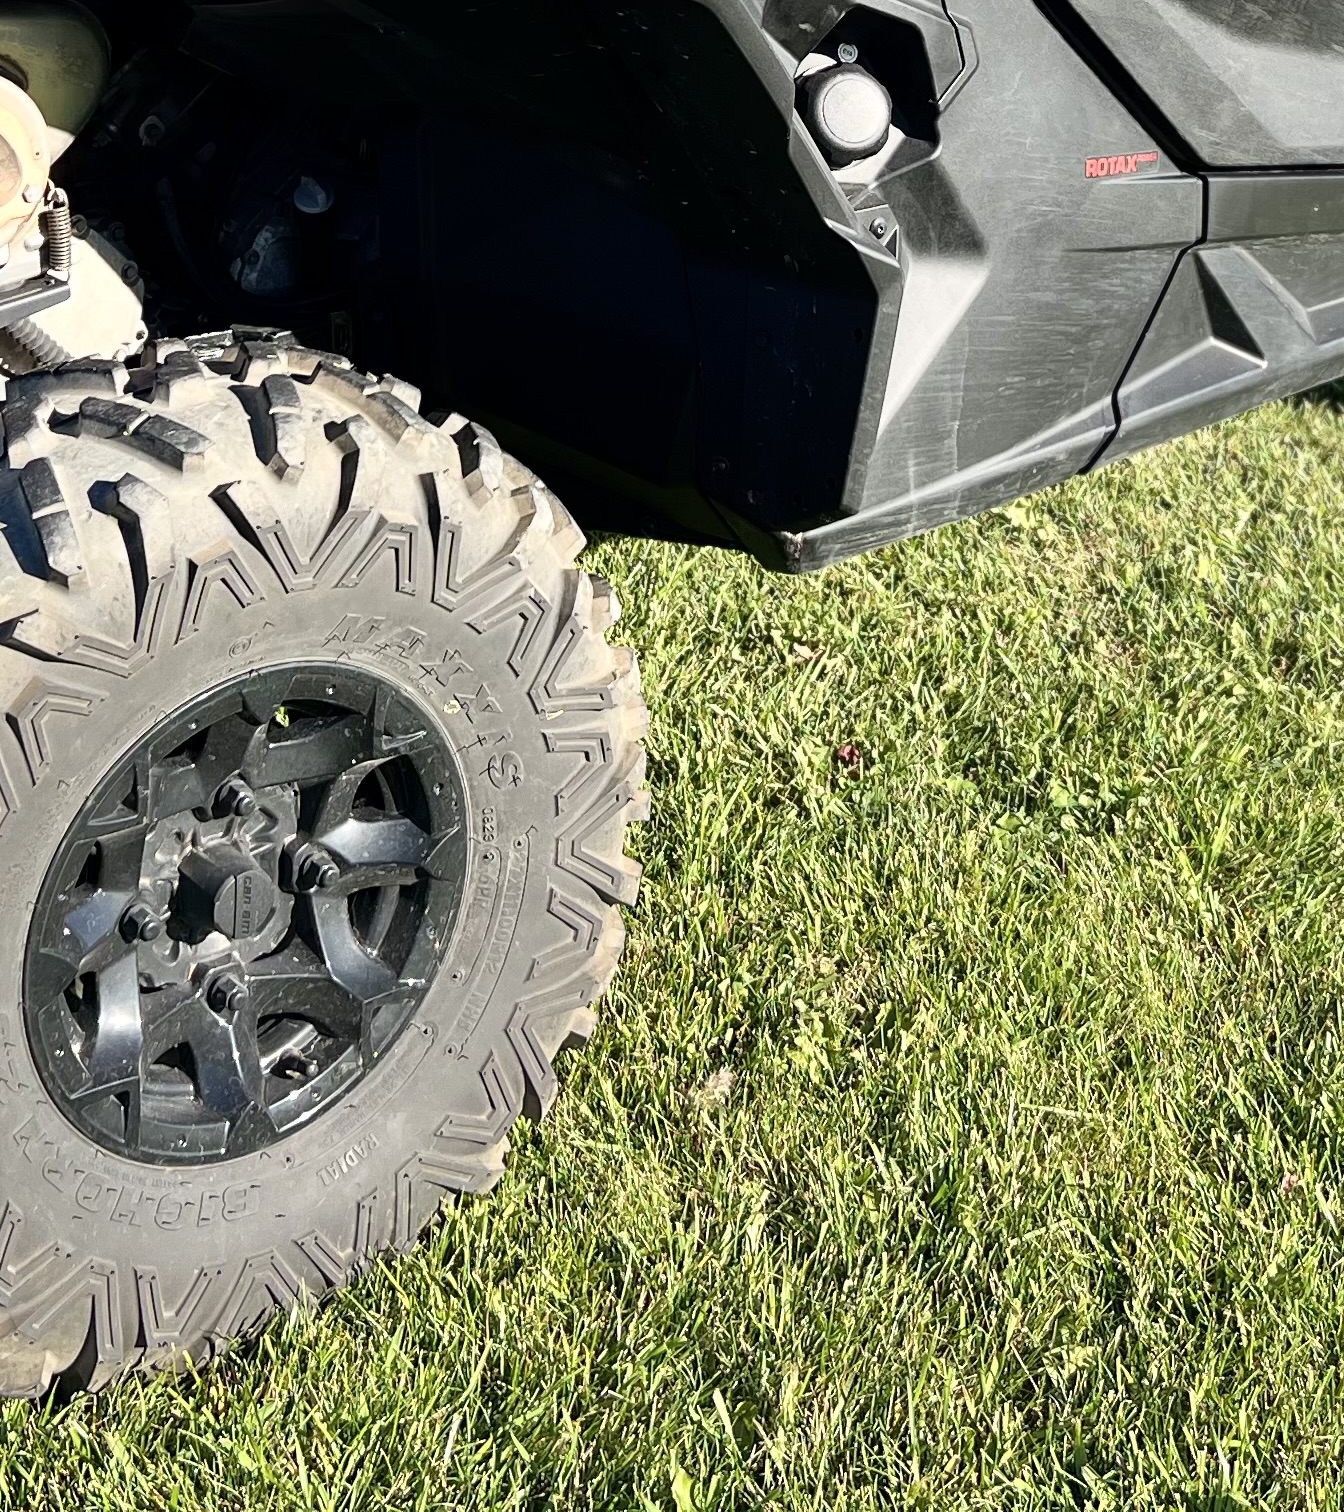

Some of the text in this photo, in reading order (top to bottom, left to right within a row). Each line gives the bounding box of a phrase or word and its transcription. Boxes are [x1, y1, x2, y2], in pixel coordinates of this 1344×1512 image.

[1085, 154, 1138, 178] ROTAX
[241, 875, 252, 935] can-am
[316, 1132, 380, 1187] RADIAL
